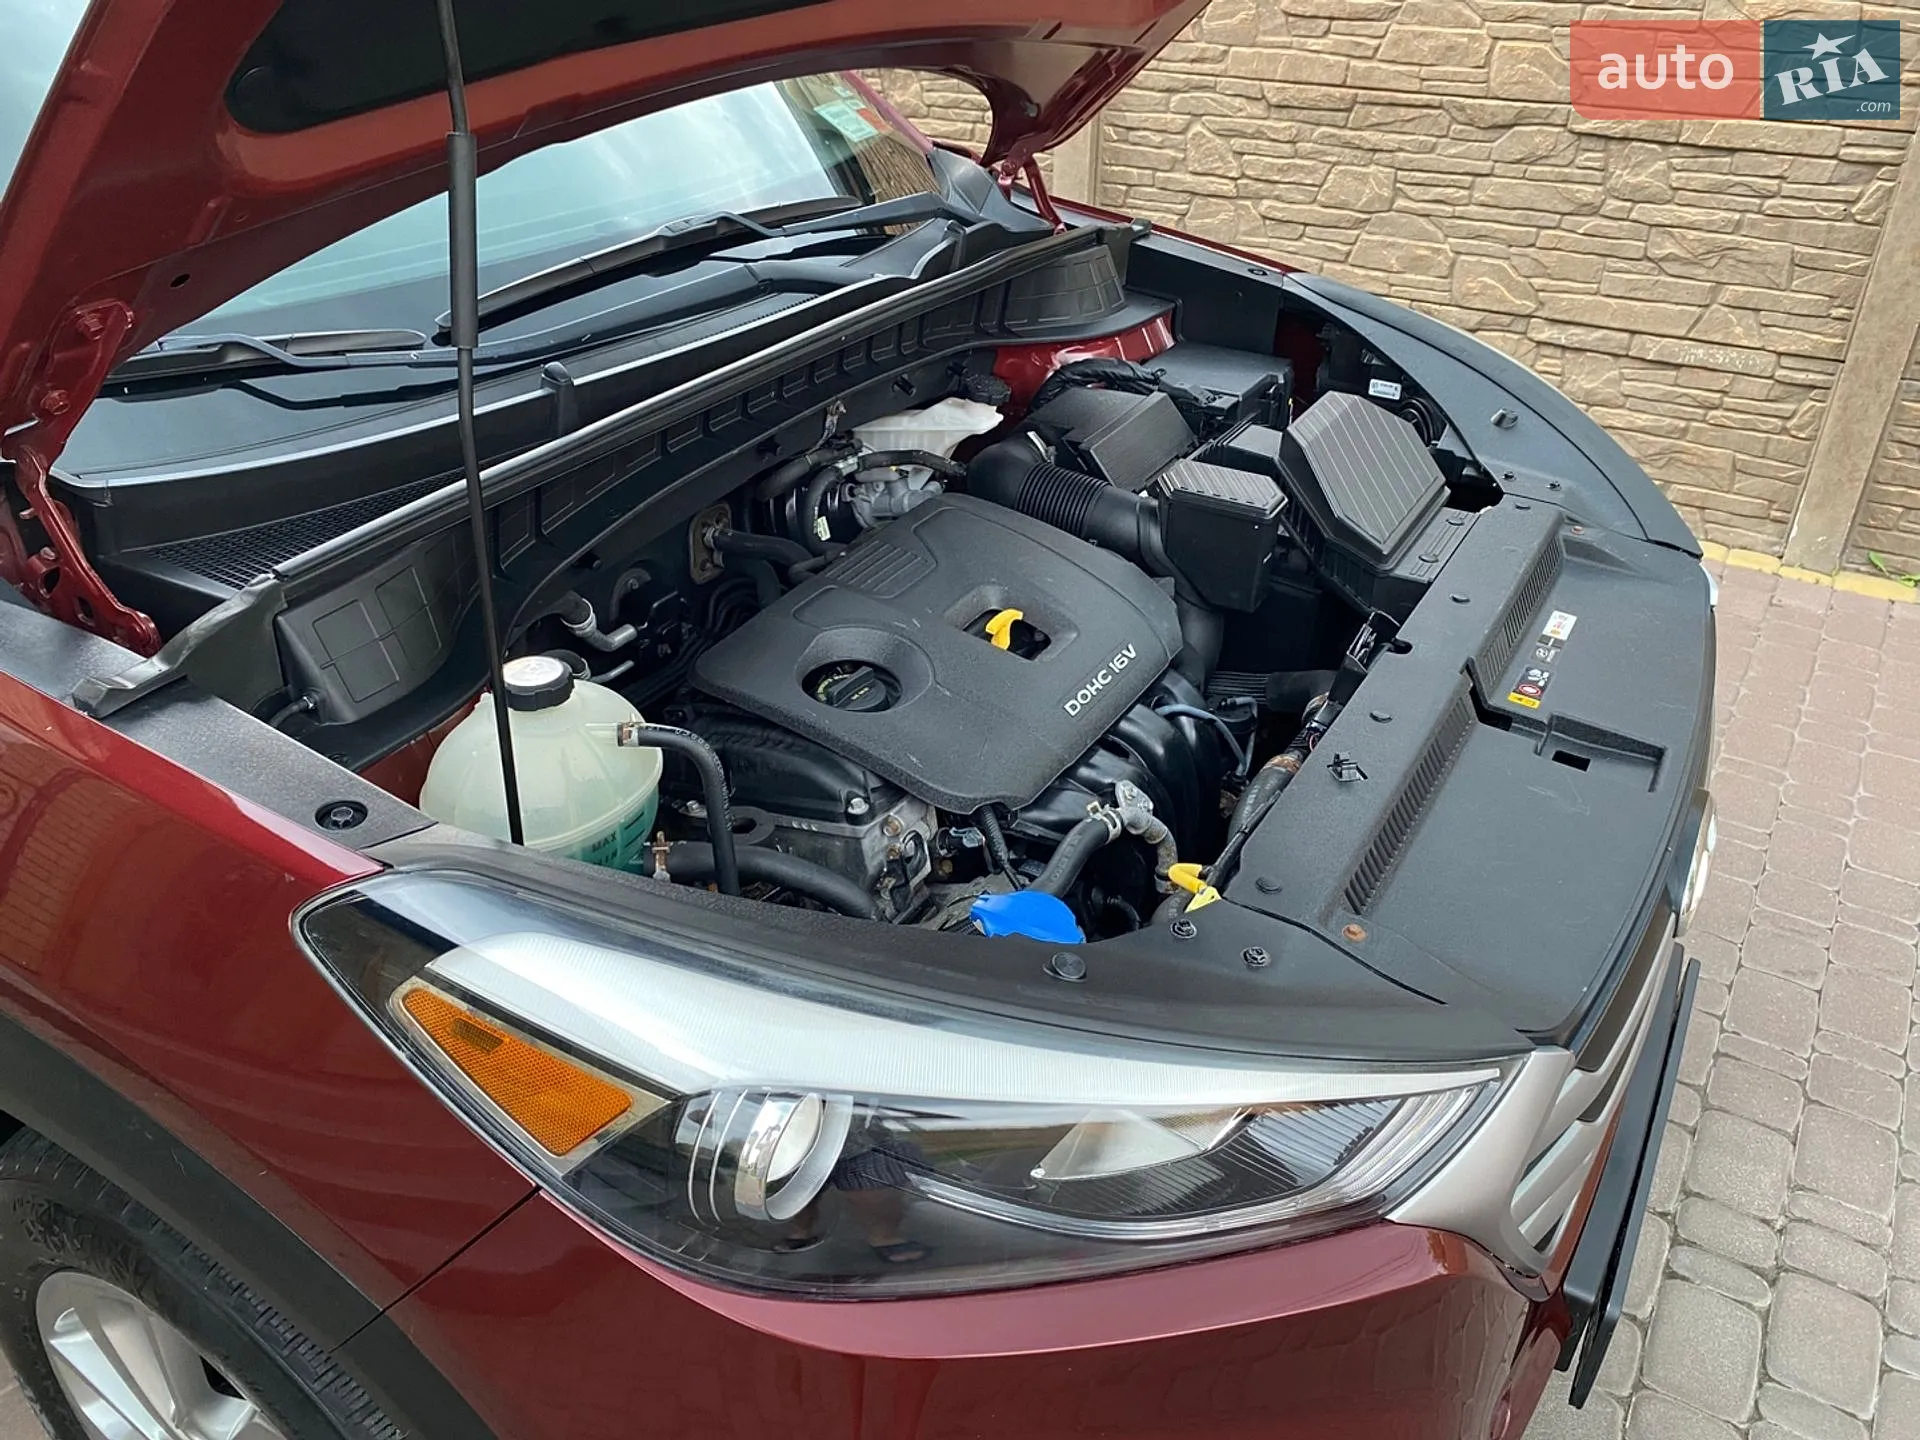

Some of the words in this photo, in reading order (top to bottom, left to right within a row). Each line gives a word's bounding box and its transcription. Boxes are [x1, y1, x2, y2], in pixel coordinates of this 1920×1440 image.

[1063, 669, 1112, 716] DOHC
[1108, 643, 1136, 673] 16V
[592, 831, 617, 852] MAX
